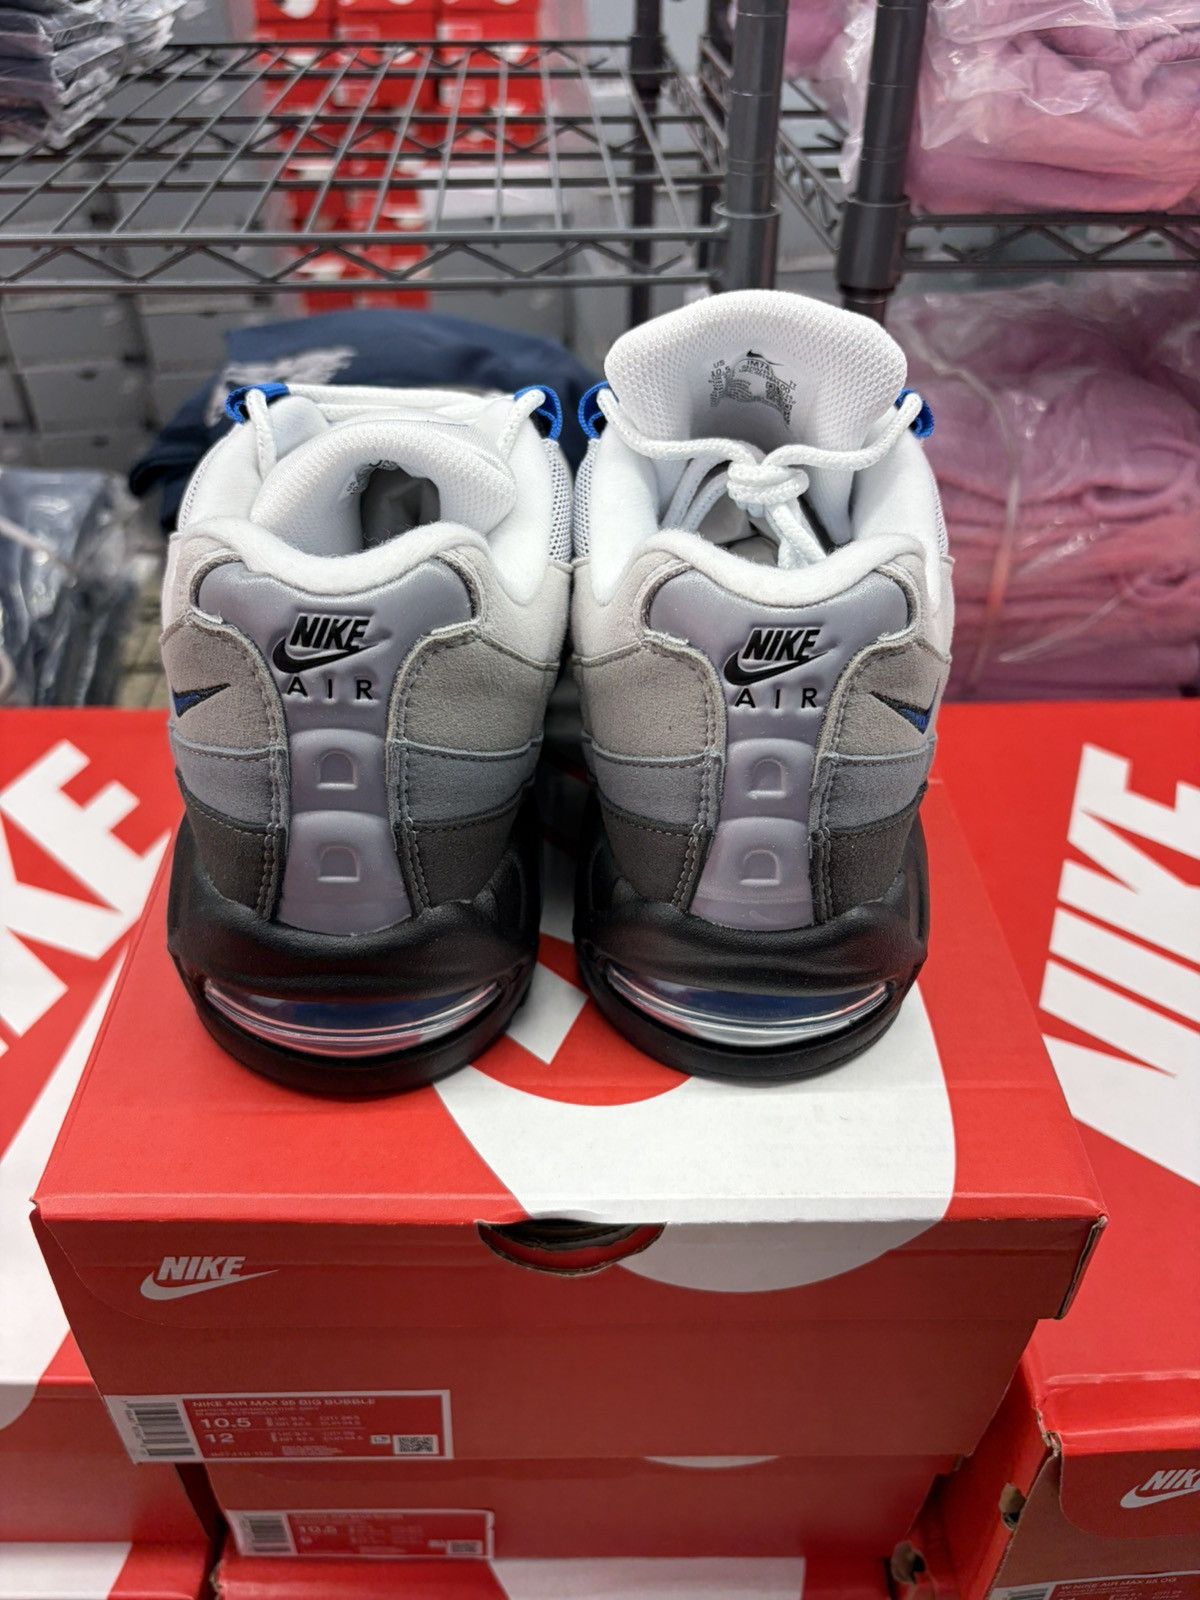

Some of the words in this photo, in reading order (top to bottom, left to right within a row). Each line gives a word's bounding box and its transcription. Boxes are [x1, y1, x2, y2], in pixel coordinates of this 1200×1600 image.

[289, 615, 370, 651] NIKE
[741, 629, 821, 661] NIKE
[286, 676, 373, 700] AIR
[734, 687, 818, 709] AIR
[157, 1255, 246, 1281] NIKE
[192, 1400, 222, 1408] NIKE
[201, 1417, 251, 1429] 10.5
[204, 1432, 235, 1443] 12
[1140, 1468, 1200, 1491] NIK
